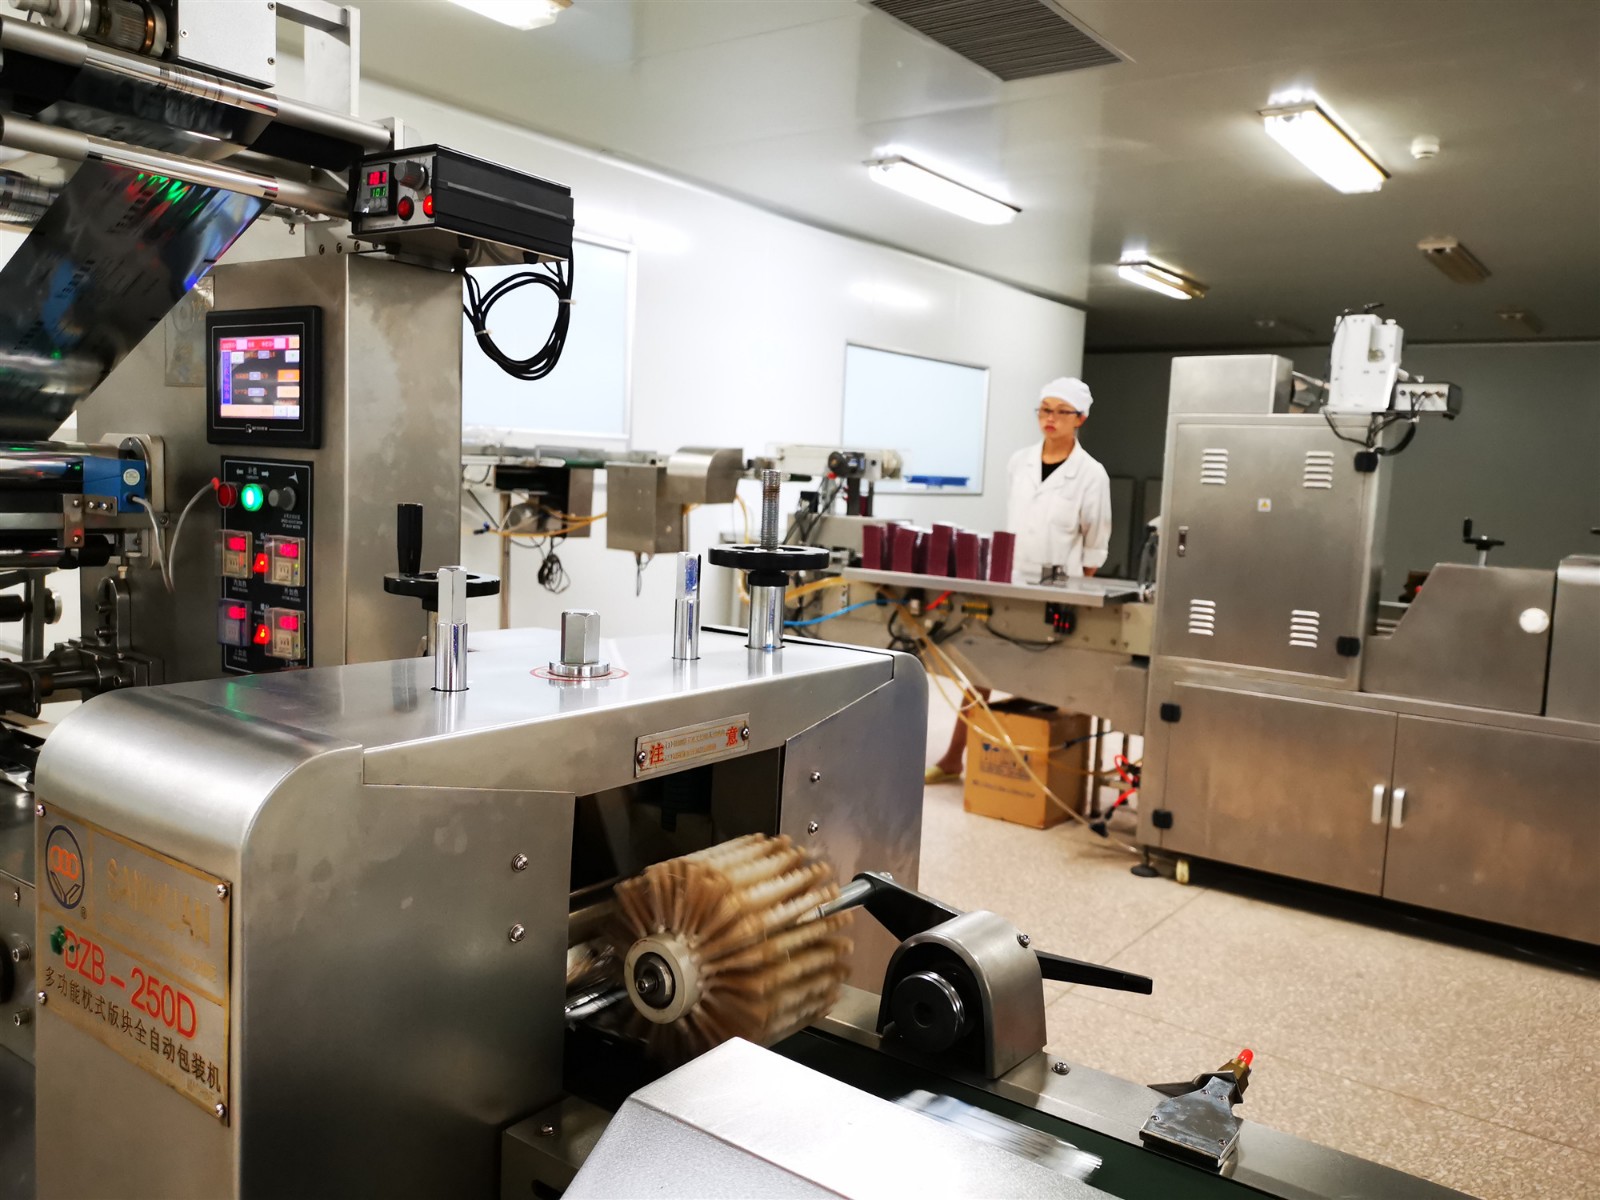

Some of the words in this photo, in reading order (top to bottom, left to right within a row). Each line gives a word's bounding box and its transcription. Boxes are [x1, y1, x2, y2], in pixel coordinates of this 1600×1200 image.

[650, 742, 664, 764] 注
[726, 726, 738, 747] 意
[45, 966, 221, 1093] 多功能枕式版块全自动包装机
